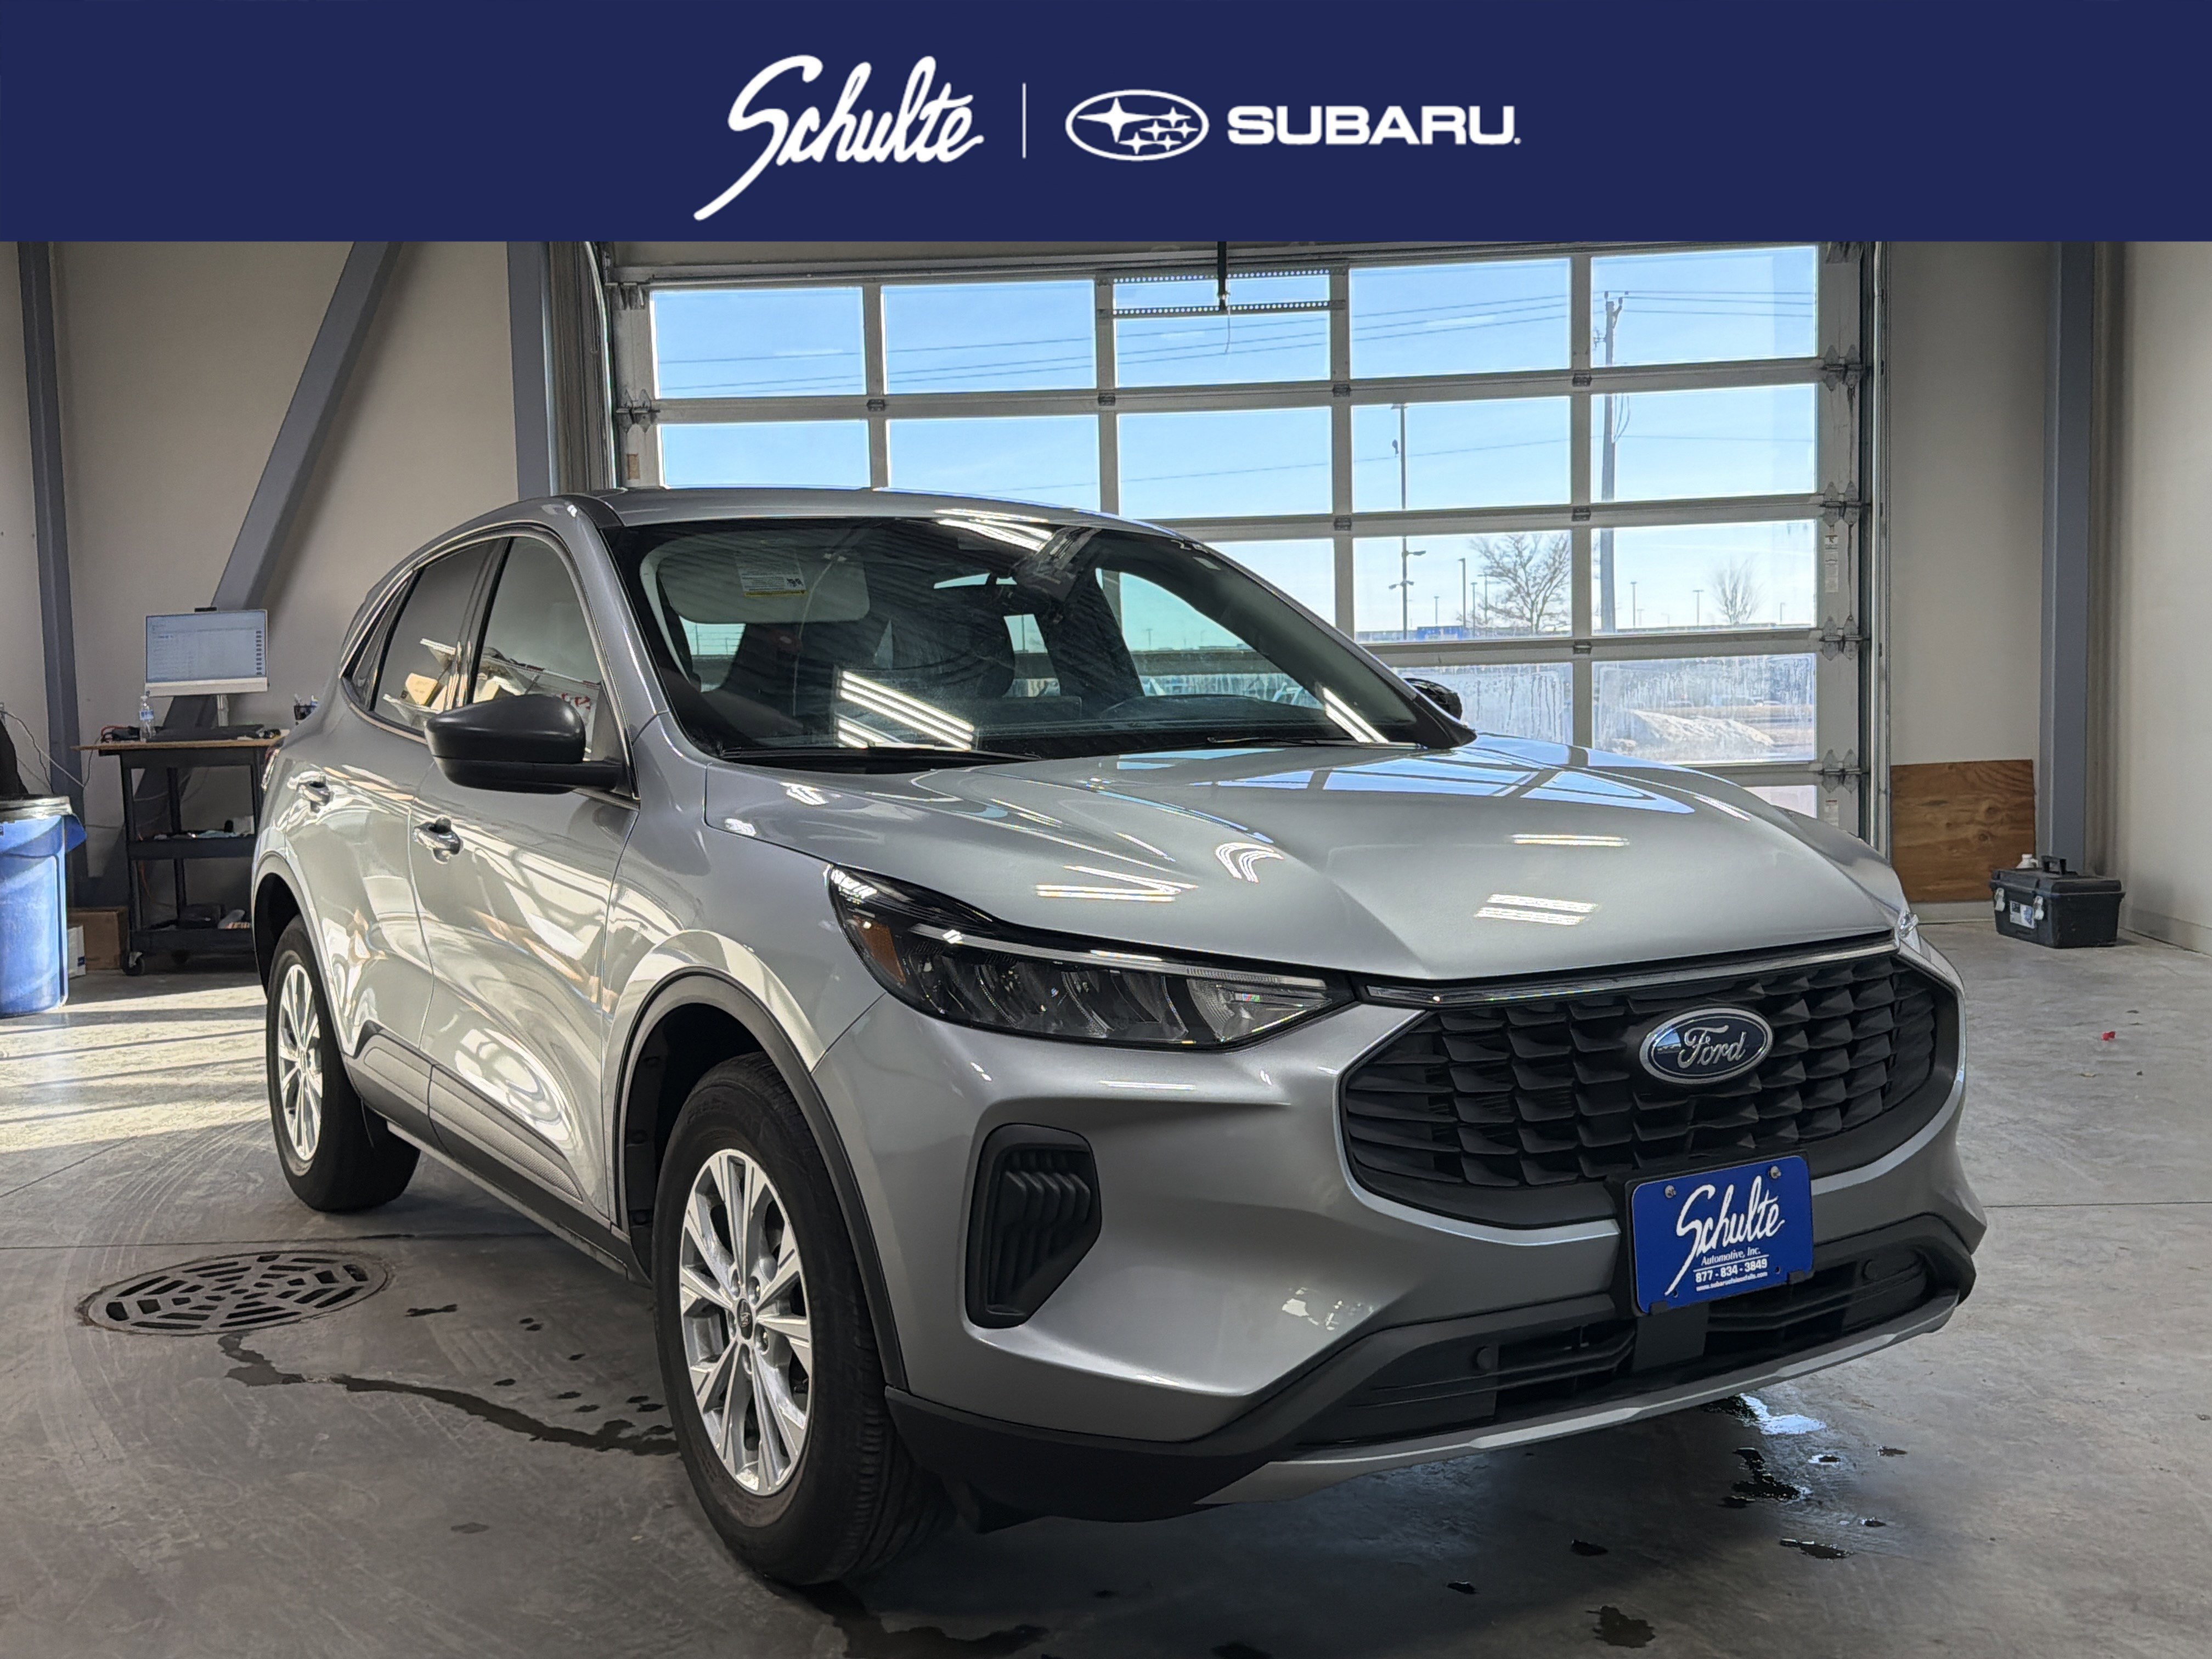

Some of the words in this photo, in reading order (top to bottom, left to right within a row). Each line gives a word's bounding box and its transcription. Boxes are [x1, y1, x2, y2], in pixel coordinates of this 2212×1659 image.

[1678, 1025, 1747, 1069] Ford
[1664, 1176, 1785, 1296] Schulte
[1747, 1246, 1761, 1256] Inc.
[1695, 1269, 1713, 1283] 877
[1720, 1265, 1738, 1278] 834
